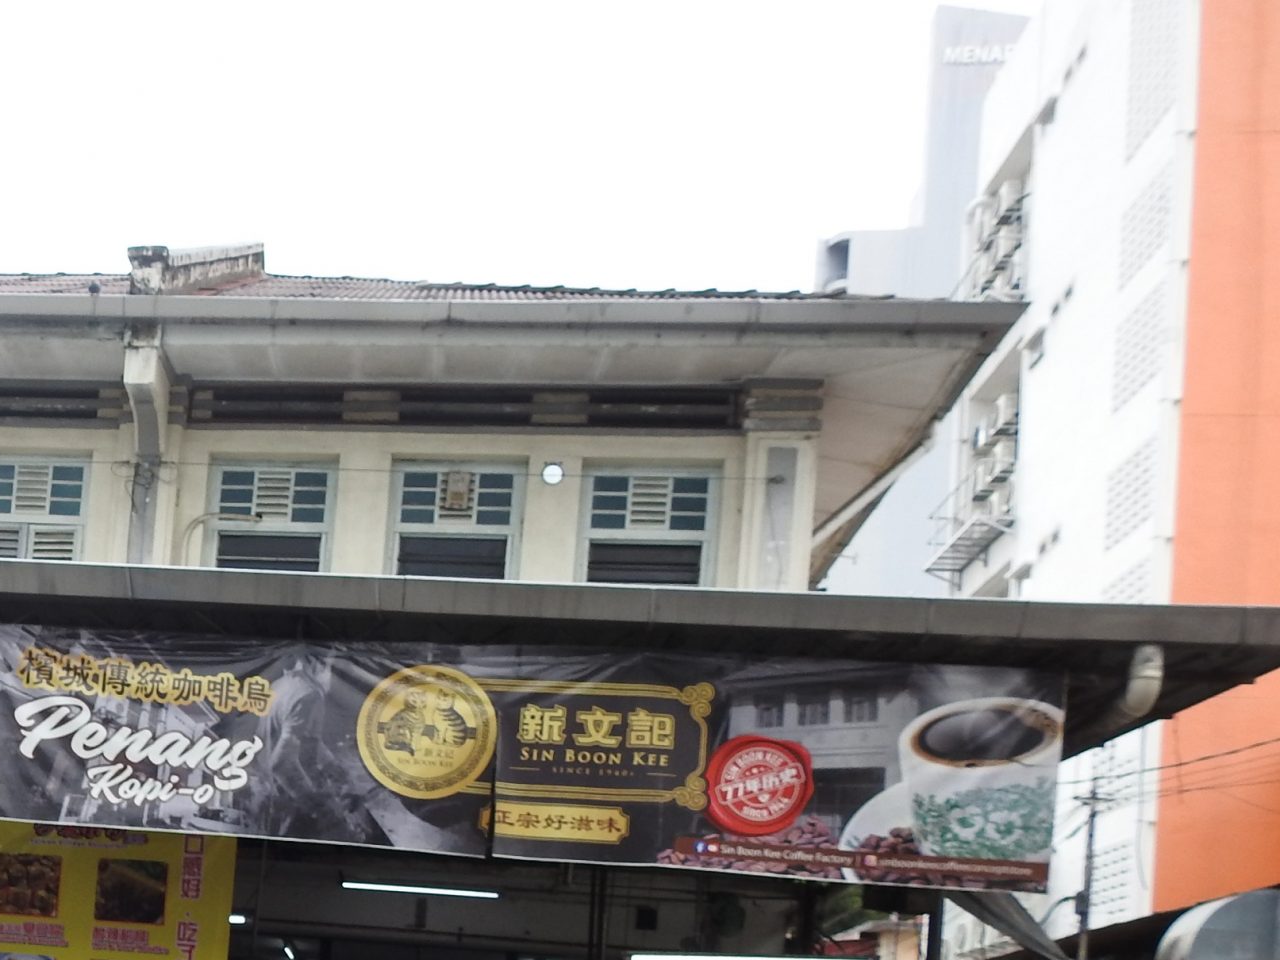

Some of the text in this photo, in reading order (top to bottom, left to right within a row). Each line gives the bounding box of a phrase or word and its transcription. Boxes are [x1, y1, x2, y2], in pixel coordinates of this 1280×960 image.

[14, 695, 264, 791] Penang
[518, 703, 676, 750] 新文記
[564, 748, 622, 765] BOON
[632, 751, 670, 767] KEE
[494, 808, 622, 834] 正宗好滋味
